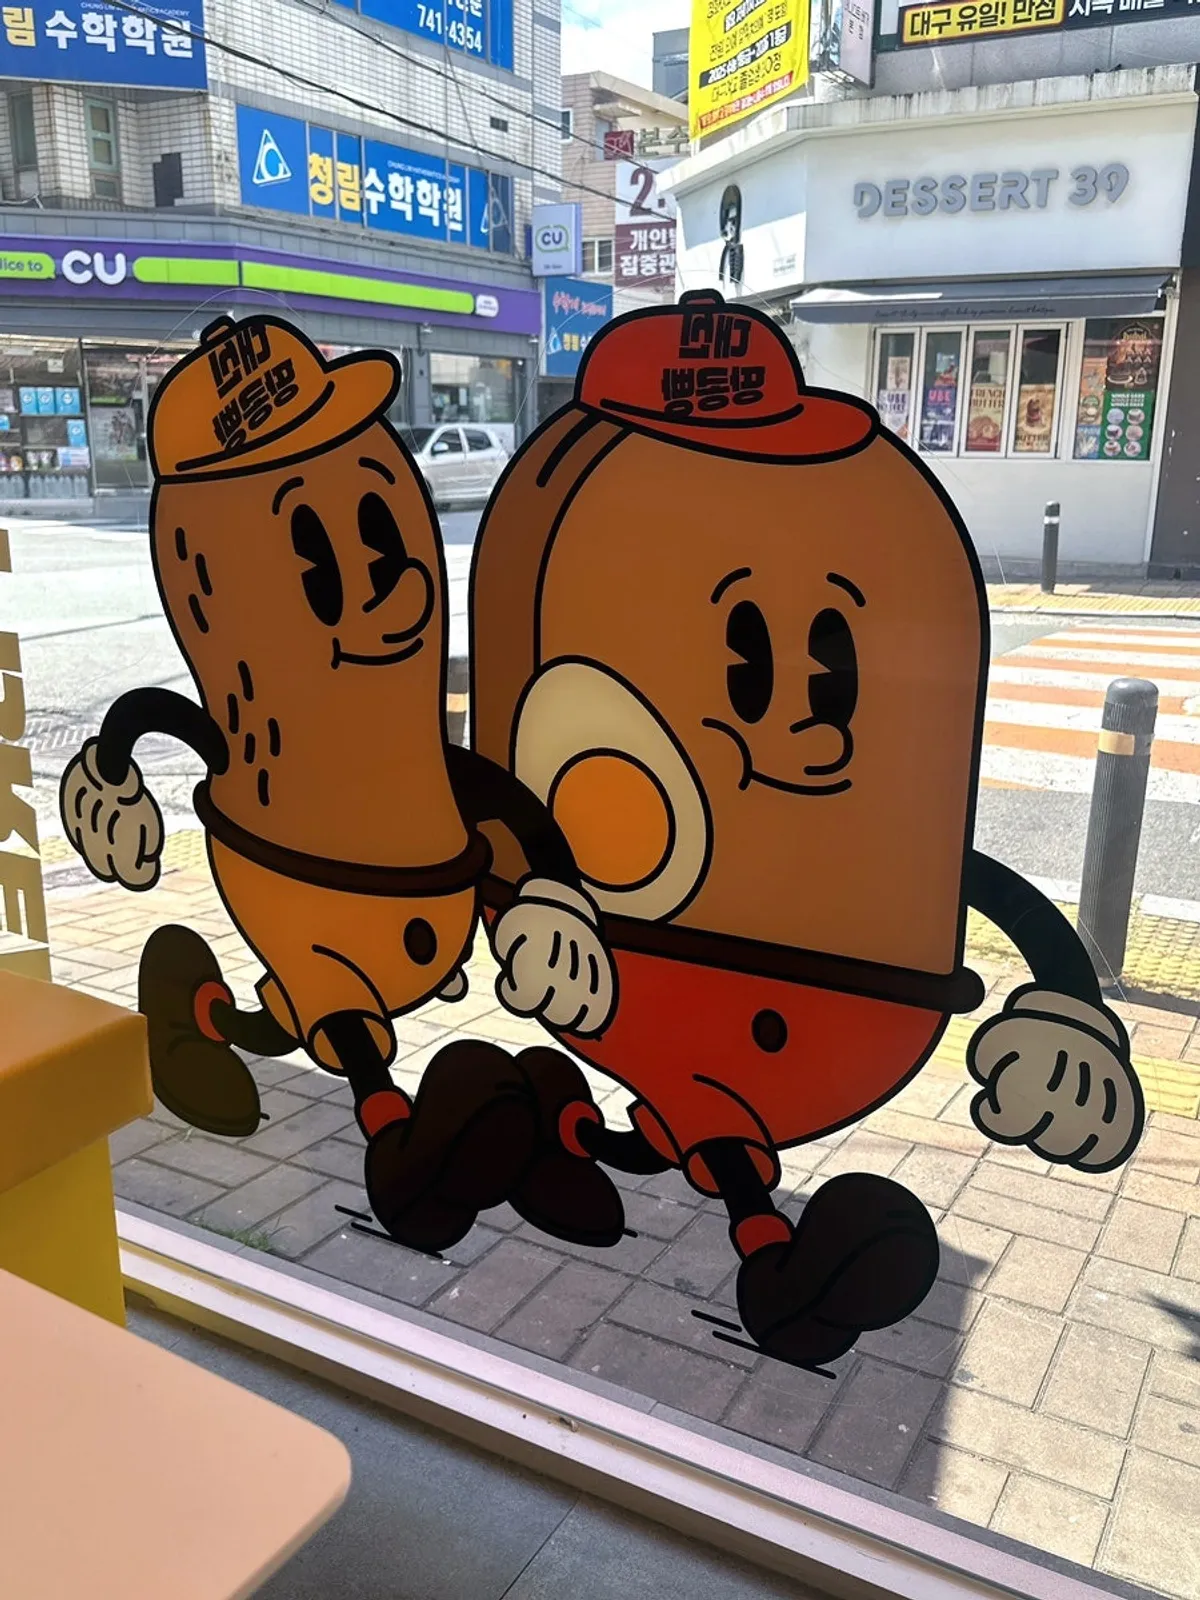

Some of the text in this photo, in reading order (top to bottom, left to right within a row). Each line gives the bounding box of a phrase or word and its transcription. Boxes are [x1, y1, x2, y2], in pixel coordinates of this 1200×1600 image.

[910, 9, 951, 36] 대구
[957, 2, 1006, 31] 유일!
[853, 162, 1130, 219] DESSERT 39
[541, 231, 563, 246] CU
[0, 257, 44, 272] ice to
[61, 249, 127, 286] CU
